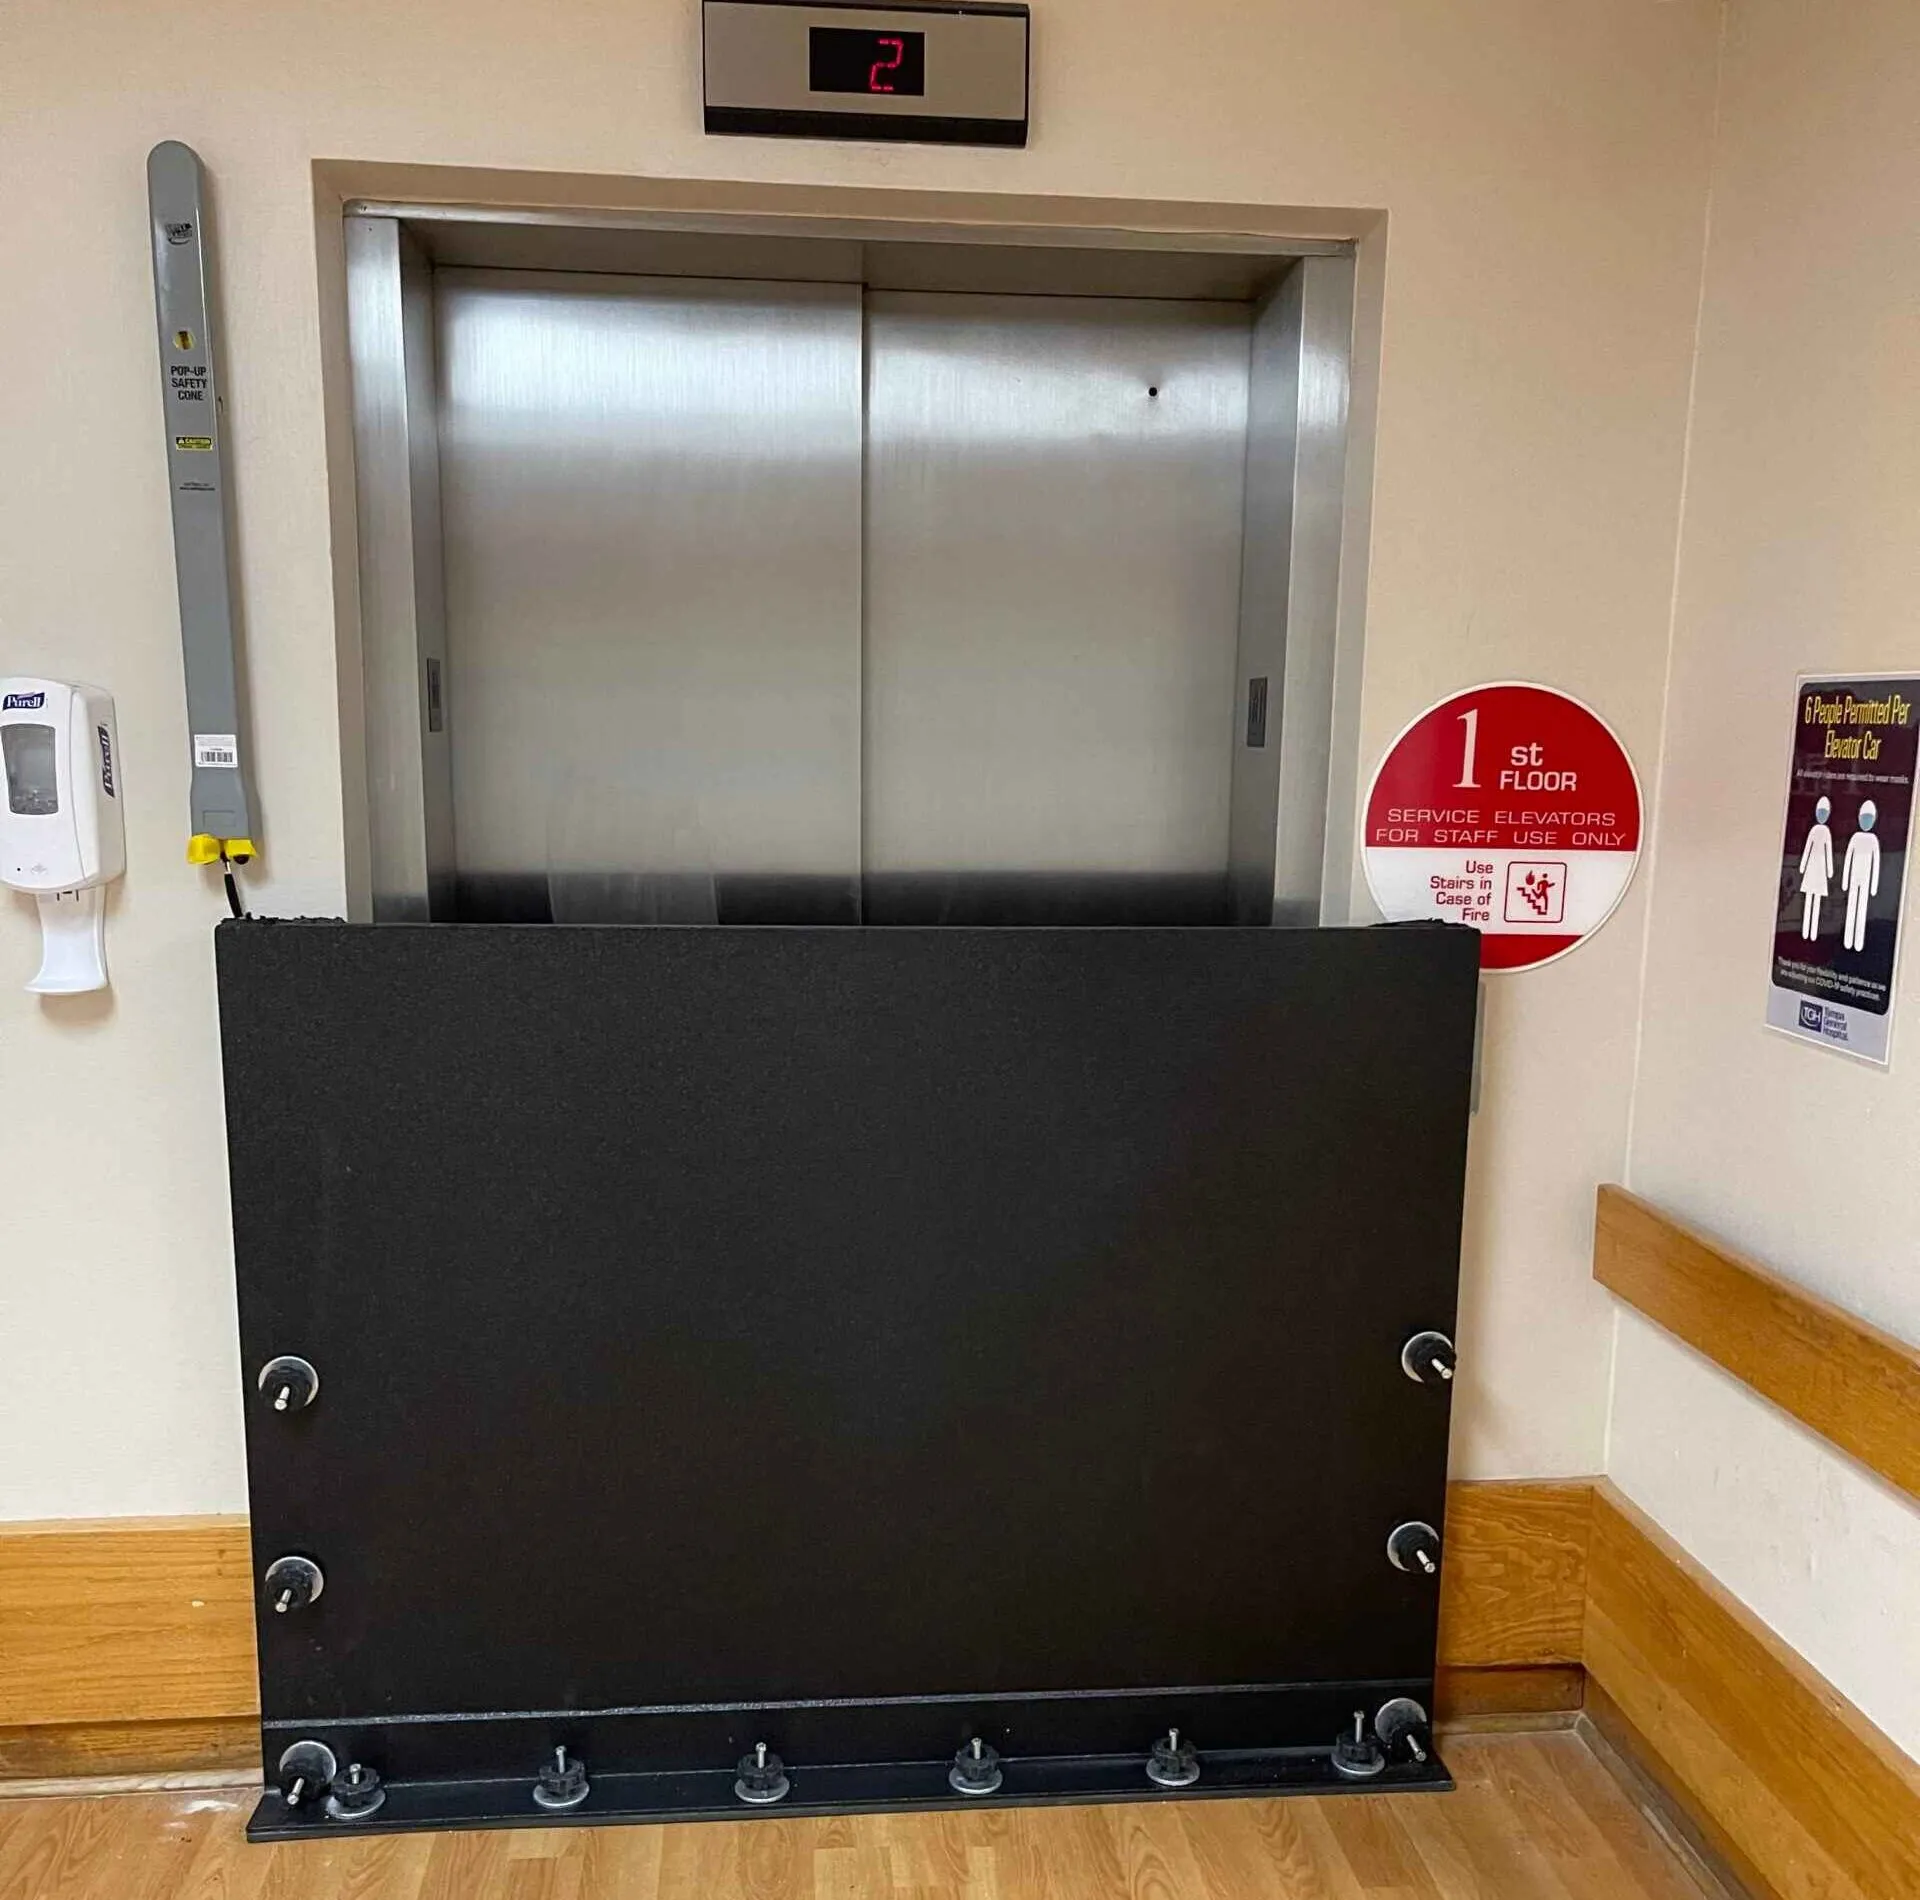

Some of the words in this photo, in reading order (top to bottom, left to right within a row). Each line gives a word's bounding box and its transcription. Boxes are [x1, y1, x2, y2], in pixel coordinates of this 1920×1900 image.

[870, 38, 904, 91] 2
[170, 365, 207, 376] POP-UP
[171, 377, 207, 389] SAFETY
[178, 390, 203, 401] CONE
[1805, 696, 1813, 724] 6
[1812, 696, 1843, 729] People
[1843, 695, 1892, 725] Permitted
[1891, 694, 1911, 725] Per
[1452, 708, 1481, 788] 1
[1510, 742, 1544, 767] st
[1824, 730, 1861, 759] Elevator
[1862, 730, 1882, 760] Car
[1499, 770, 1577, 792] FLOOR
[1387, 808, 1480, 824] SERVICE
[1494, 810, 1616, 826] ELEVATORS
[1376, 828, 1419, 843] FOR
[1434, 829, 1499, 844] STAFF
[1513, 830, 1557, 845] USE
[1572, 832, 1627, 846] ONLY
[1465, 860, 1494, 874] Use
[1430, 875, 1475, 890] Stairs
[1479, 876, 1492, 890] in
[1436, 891, 1472, 906] Case
[1477, 892, 1492, 906] of
[1461, 907, 1490, 922] Fire
